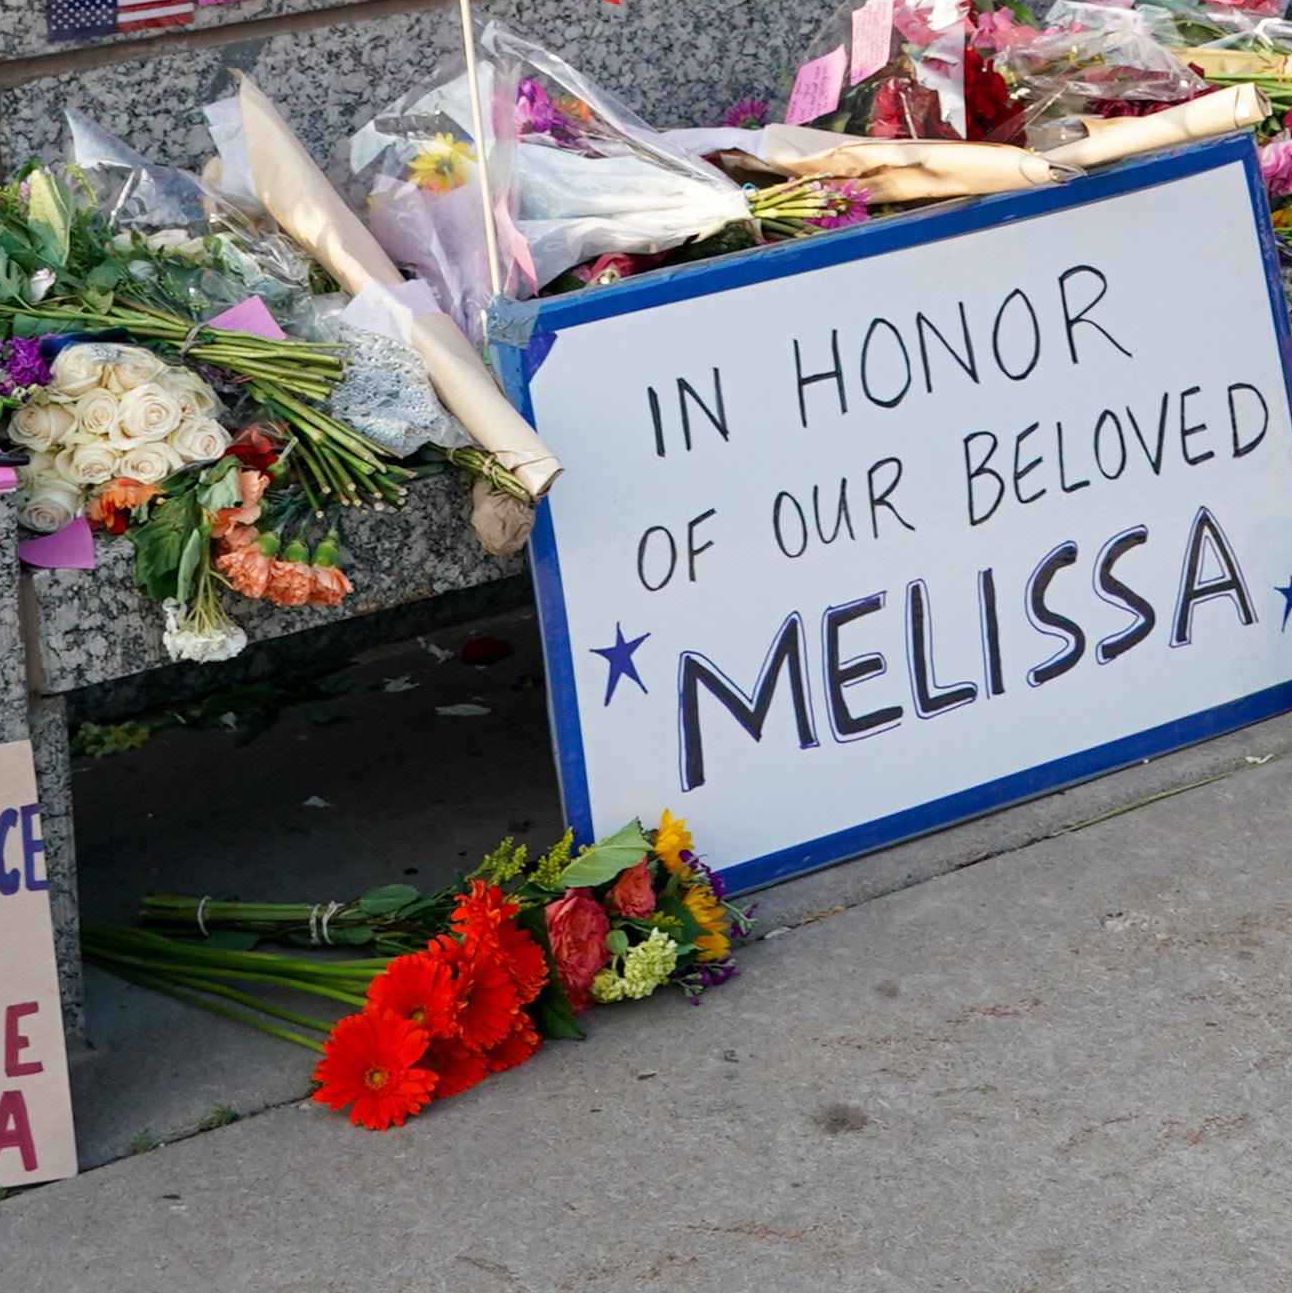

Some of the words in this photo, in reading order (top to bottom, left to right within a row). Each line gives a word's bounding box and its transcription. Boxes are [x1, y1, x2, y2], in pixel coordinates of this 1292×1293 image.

[647, 366, 729, 457] IN
[792, 264, 1132, 428] HONOR
[636, 508, 717, 590] OF
[772, 456, 916, 559] OUR
[963, 383, 1269, 526] BELOVED
[678, 506, 1258, 793] MELISSA
